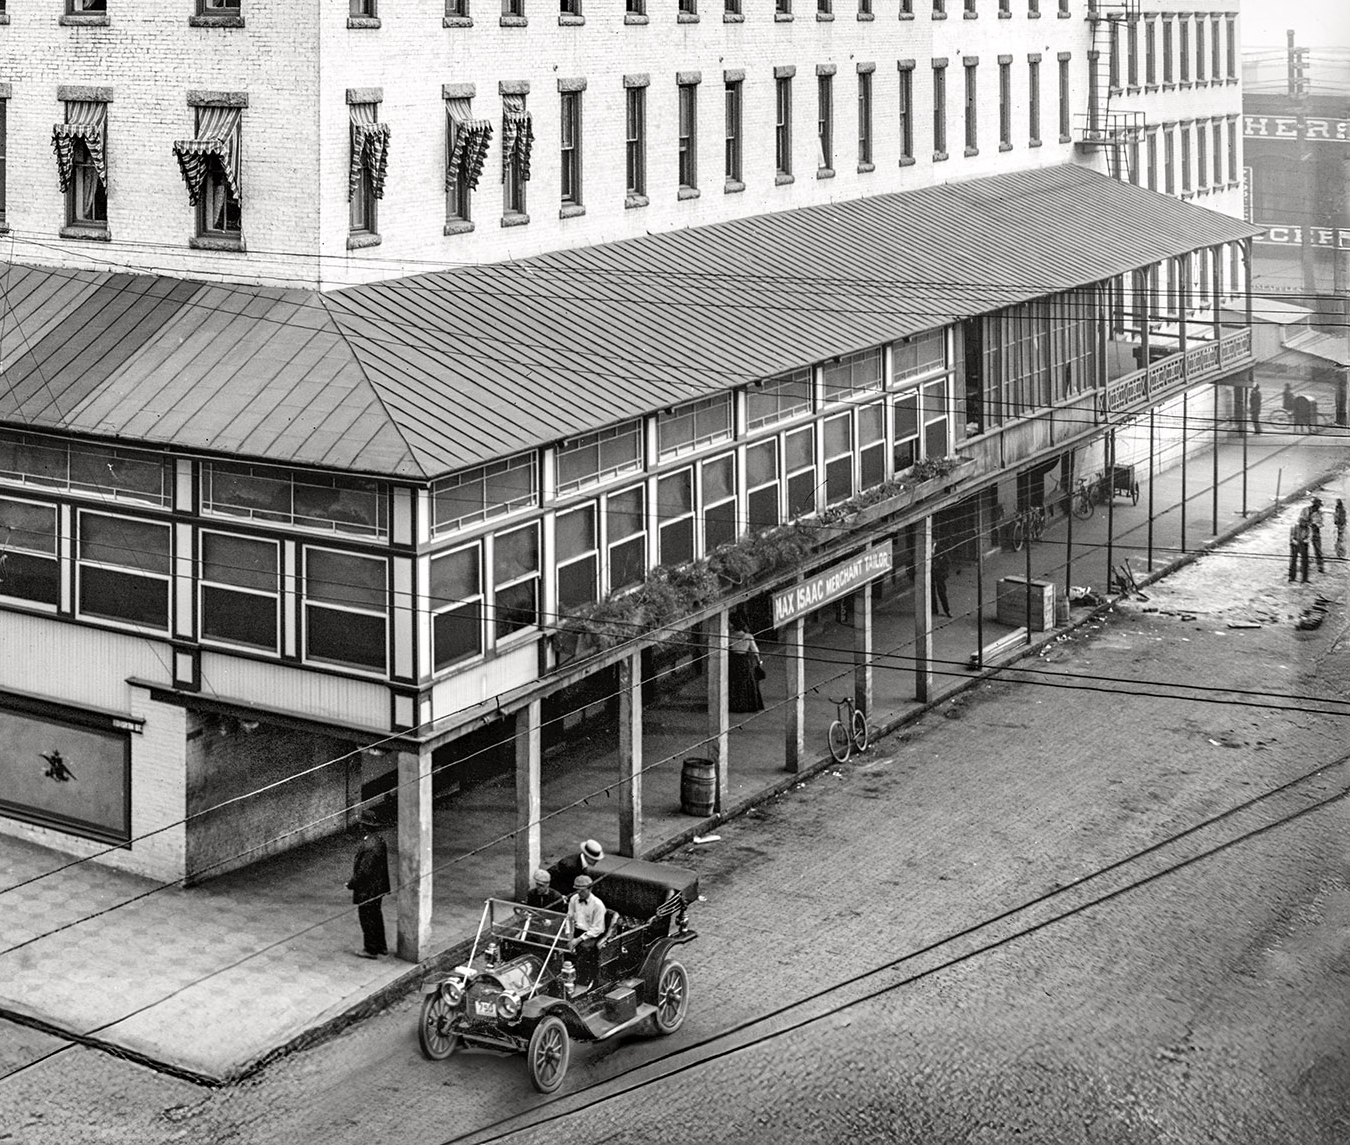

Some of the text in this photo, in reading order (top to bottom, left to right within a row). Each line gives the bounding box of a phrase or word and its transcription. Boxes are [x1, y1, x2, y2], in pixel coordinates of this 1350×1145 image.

[775, 593, 795, 622] MAX
[797, 579, 824, 611] ISAAC
[826, 559, 862, 596] MERCHANT
